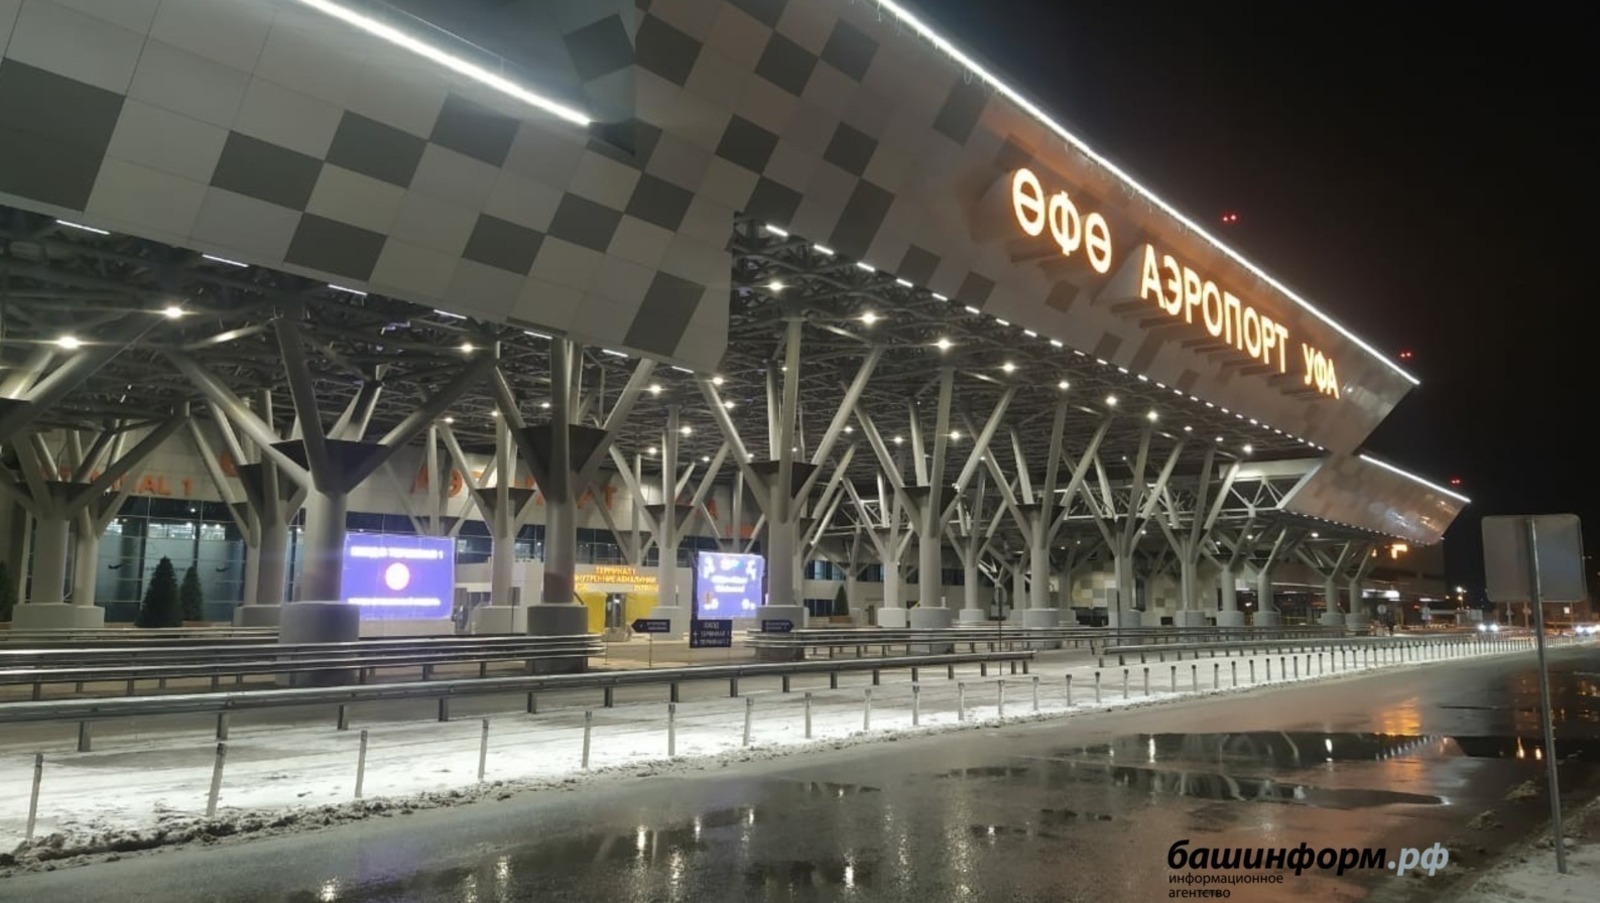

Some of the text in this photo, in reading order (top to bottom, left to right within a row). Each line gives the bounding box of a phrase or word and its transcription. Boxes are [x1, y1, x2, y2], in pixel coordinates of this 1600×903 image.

[1012, 168, 1112, 274] ӨФӨ
[1140, 243, 1340, 399] АЭРОПОРТ УФА
